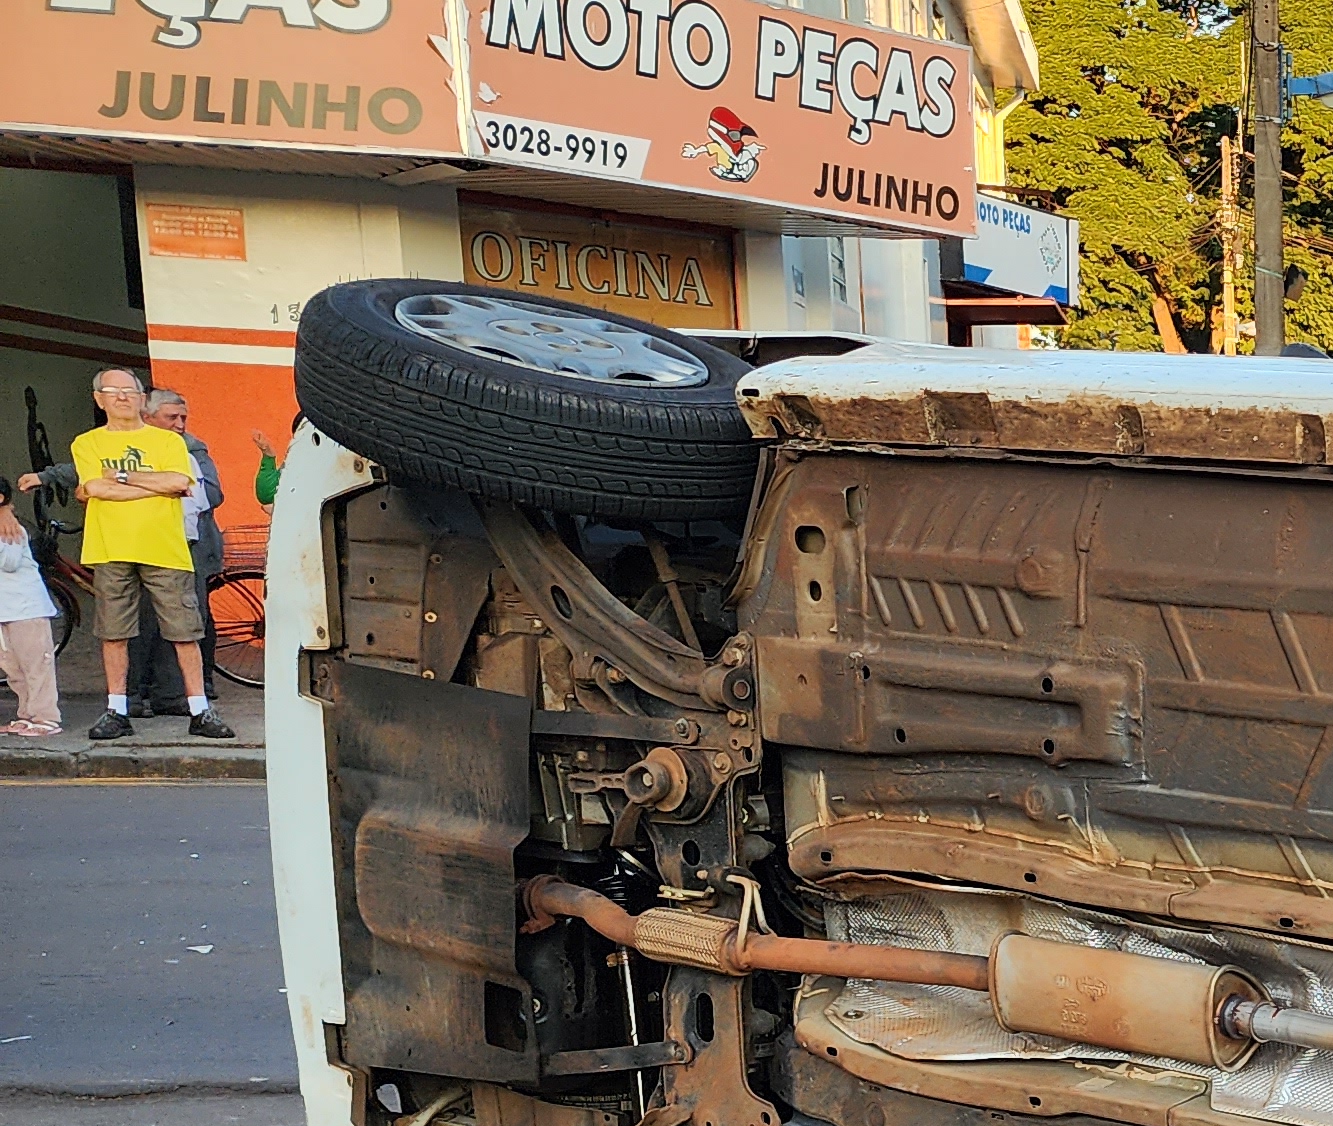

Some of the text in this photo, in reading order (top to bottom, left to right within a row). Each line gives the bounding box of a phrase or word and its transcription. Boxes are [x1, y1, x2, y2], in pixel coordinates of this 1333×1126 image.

[97, 70, 424, 135] JULINHO
[755, 15, 957, 145] PEÇAS
[485, 120, 629, 169] 3028-9919
[813, 162, 960, 222] JULINHO
[977, 200, 1032, 238] OTO PEÇAS
[470, 230, 714, 308] OFICINA
